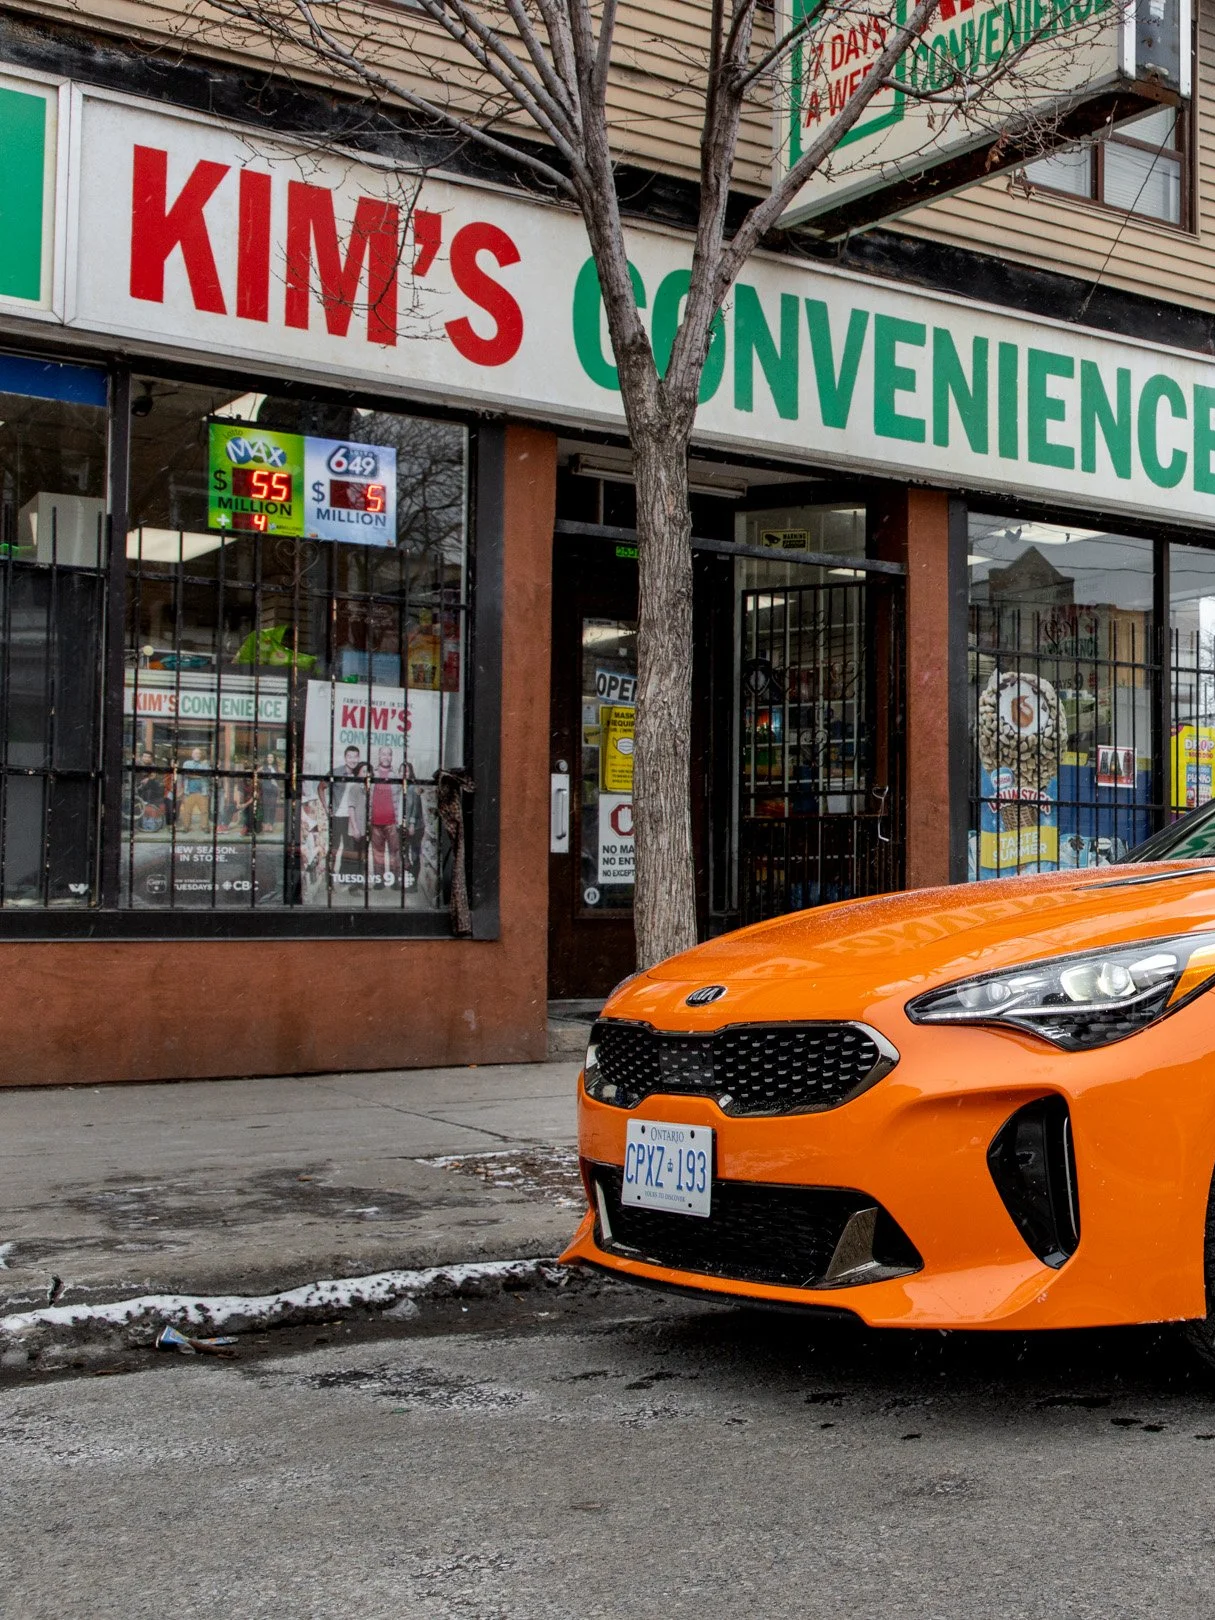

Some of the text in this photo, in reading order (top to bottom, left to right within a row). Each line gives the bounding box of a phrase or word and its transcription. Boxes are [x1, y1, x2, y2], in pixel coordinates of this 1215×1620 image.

[811, 42, 825, 81] 7
[831, 13, 887, 72] DAYS
[910, 0, 1112, 92] CONVENIENC
[805, 88, 822, 129] A
[130, 143, 524, 367] KIM'S
[226, 438, 285, 468] MAX
[213, 469, 291, 502] $ 55
[312, 481, 383, 512] $ 5
[217, 496, 293, 517] MILLION
[316, 507, 387, 528] MILLION
[253, 514, 266, 532] 4
[597, 673, 637, 702] OPE
[133, 693, 177, 713] KIM'S
[341, 704, 412, 733] KIM'S
[602, 845, 617, 854] NO
[602, 857, 616, 866] NO
[331, 871, 395, 887] TUESDYS 9
[625, 1142, 707, 1194] CPXZ 193
